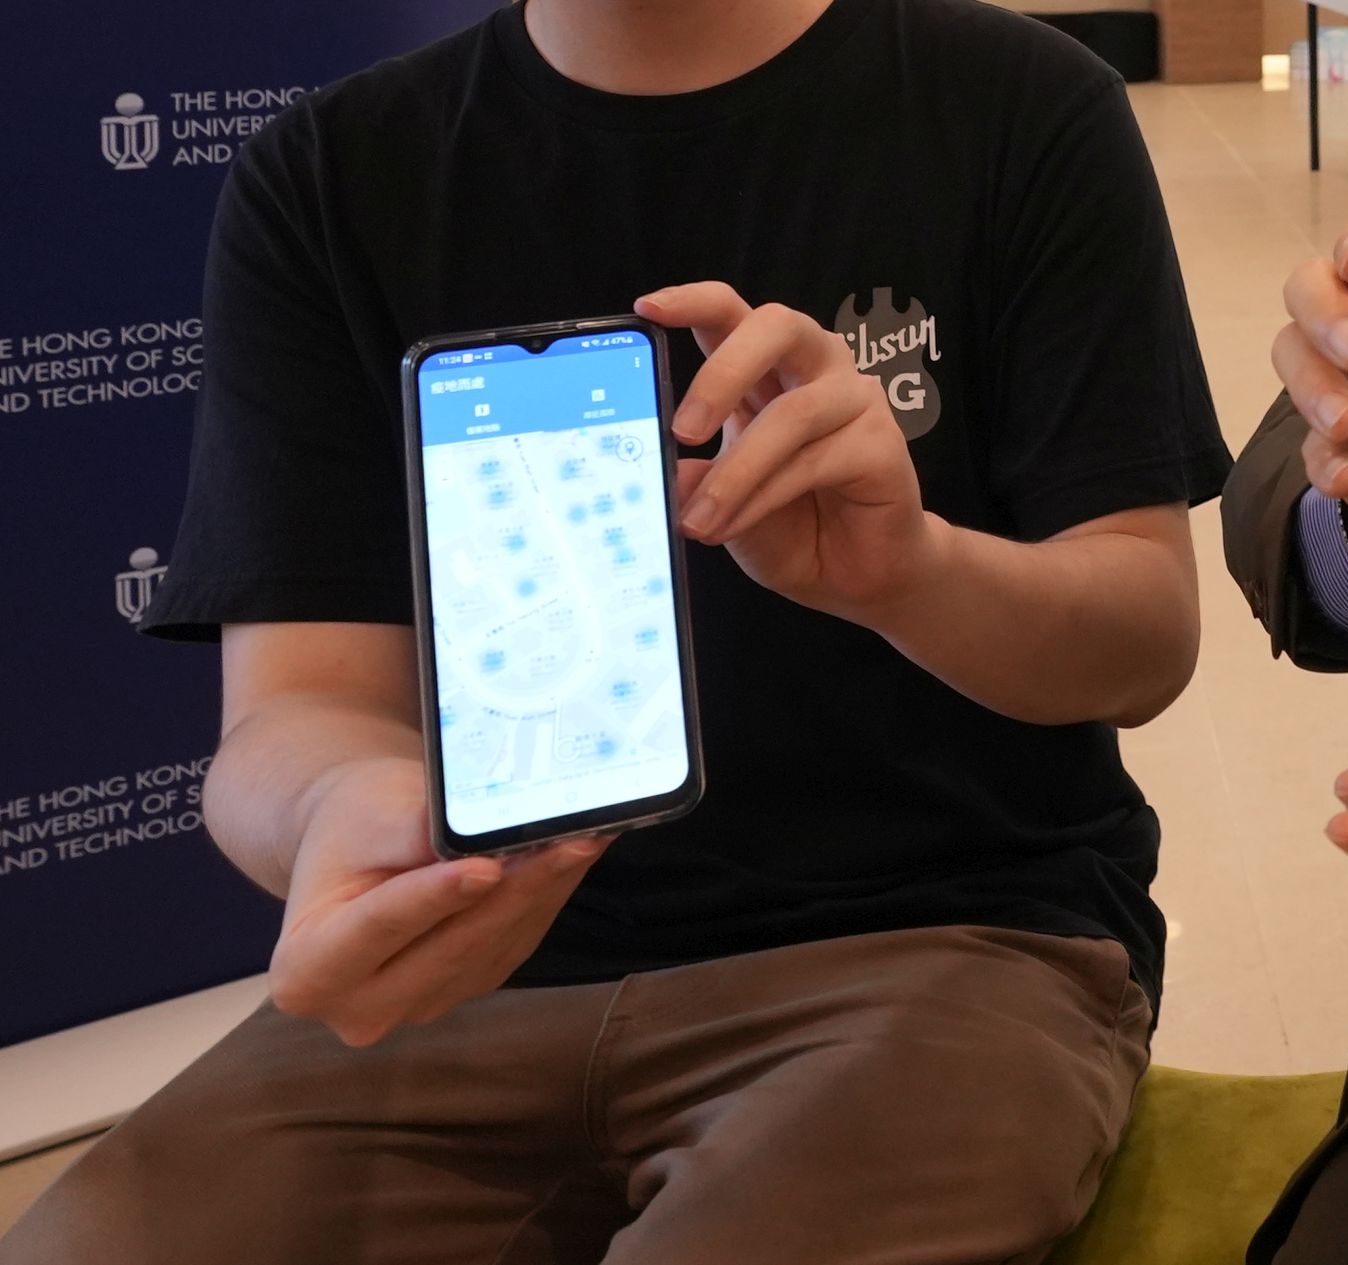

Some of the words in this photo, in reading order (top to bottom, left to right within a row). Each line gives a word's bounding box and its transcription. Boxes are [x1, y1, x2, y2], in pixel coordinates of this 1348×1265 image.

[170, 91, 217, 113] THE
[172, 115, 276, 139] UNIVER
[172, 144, 232, 166] AND
[22, 328, 112, 356] HONG
[121, 318, 204, 345] KONG
[838, 315, 941, 371] ibson
[0, 354, 118, 386] IVERSITY
[126, 349, 163, 371] OF
[38, 371, 202, 409] TECHNOLOG
[0, 797, 30, 821] HE
[39, 776, 128, 812] HONG
[0, 799, 134, 847] NIVERSITY
[142, 790, 178, 815] OF
[54, 810, 201, 860] TECHNOLO
